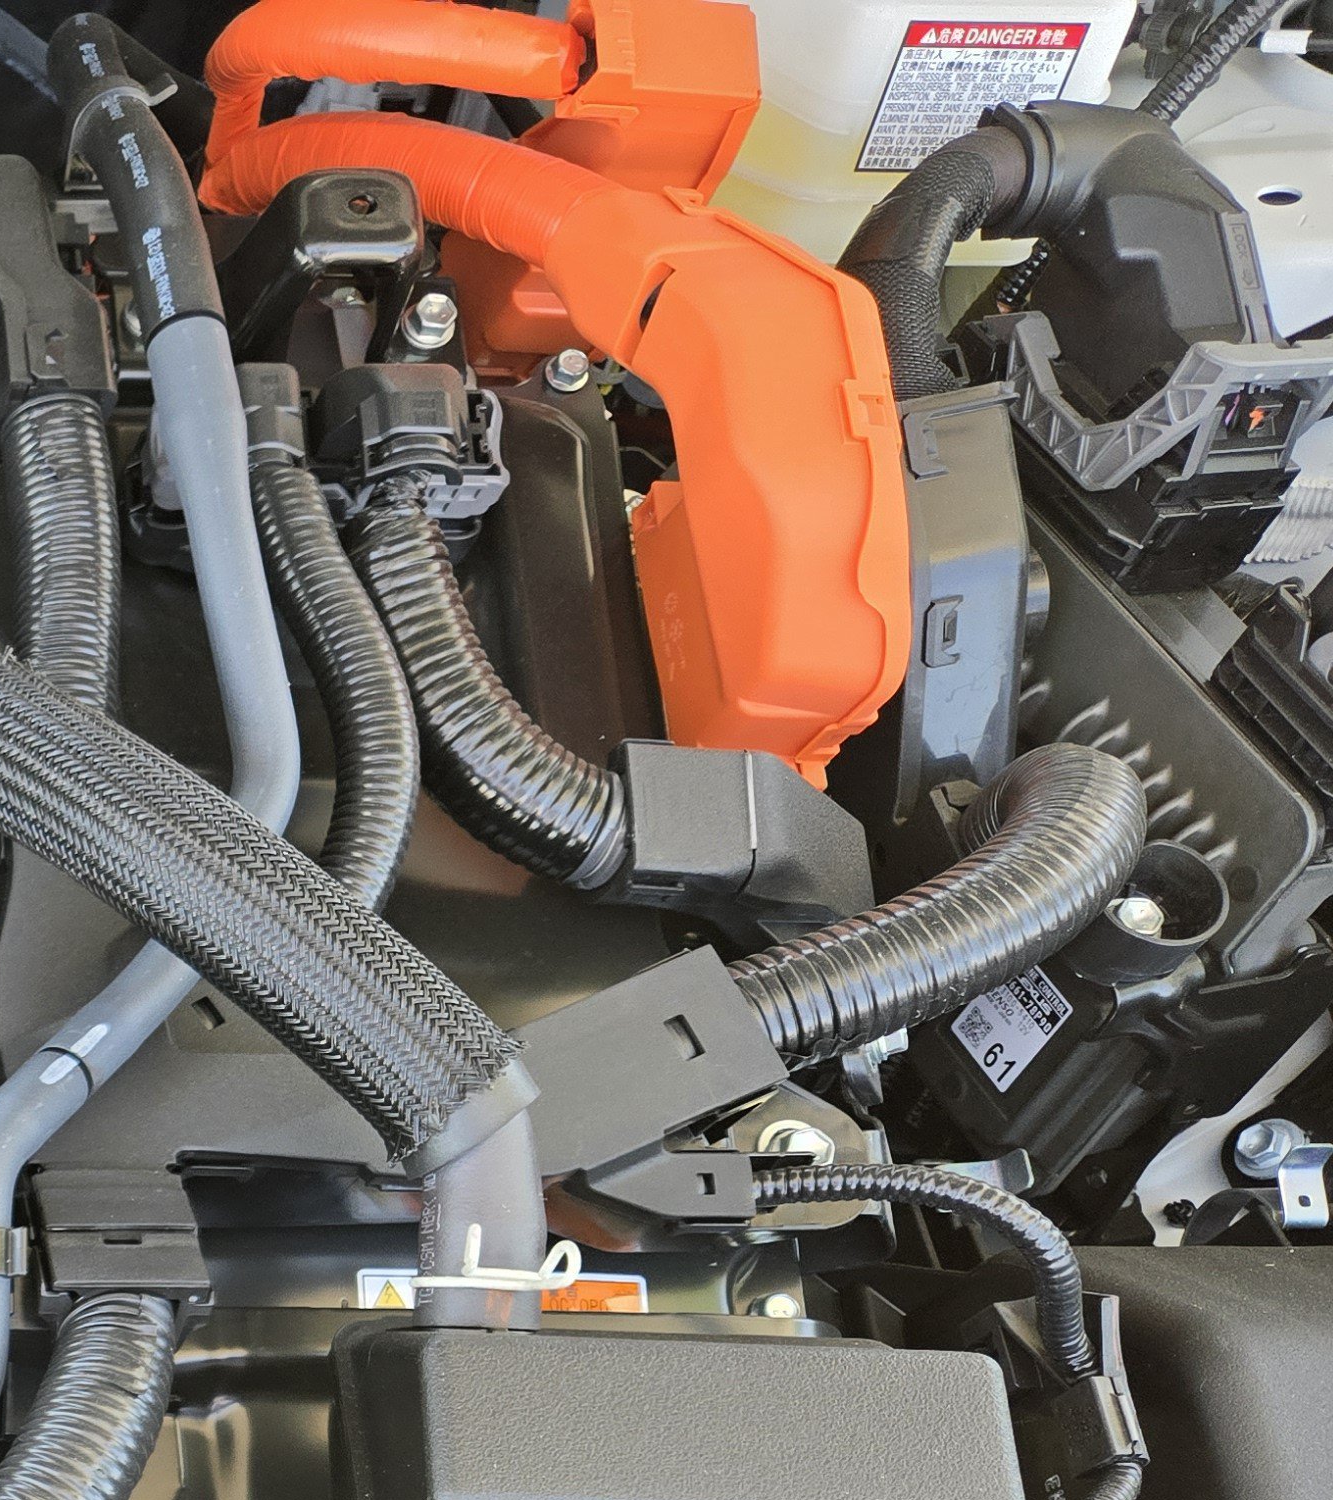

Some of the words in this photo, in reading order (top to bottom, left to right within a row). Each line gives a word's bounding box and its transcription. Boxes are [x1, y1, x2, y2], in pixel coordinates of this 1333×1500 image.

[936, 28, 965, 44] 危険
[965, 29, 1038, 45] DANGER
[895, 73, 914, 81] HIGH
[916, 73, 953, 82] PRESSURE
[955, 73, 979, 82] INSIDE
[980, 74, 1005, 82] BRAKE
[1007, 74, 1037, 83] SYSTEM
[955, 82, 970, 91] THE
[971, 83, 996, 92] BRAKE
[998, 83, 1027, 92] SYSTEM
[1027, 84, 1058, 93] BEFORE
[967, 93, 978, 101] OR
[883, 102, 916, 112] PRESSION
[943, 103, 961, 112] DANS
[963, 103, 973, 112] LE
[910, 114, 920, 123] LA
[921, 114, 952, 123] PRESSION
[954, 114, 965, 123] DU
[875, 125, 896, 134] AVANT
[898, 125, 908, 134] DE
[895, 136, 907, 145] OU
[907, 136, 918, 145] AU
[1019, 976, 1053, 1016] EXUS
[1038, 980, 1069, 1018] CONTROL
[983, 1042, 1016, 1083] 61
